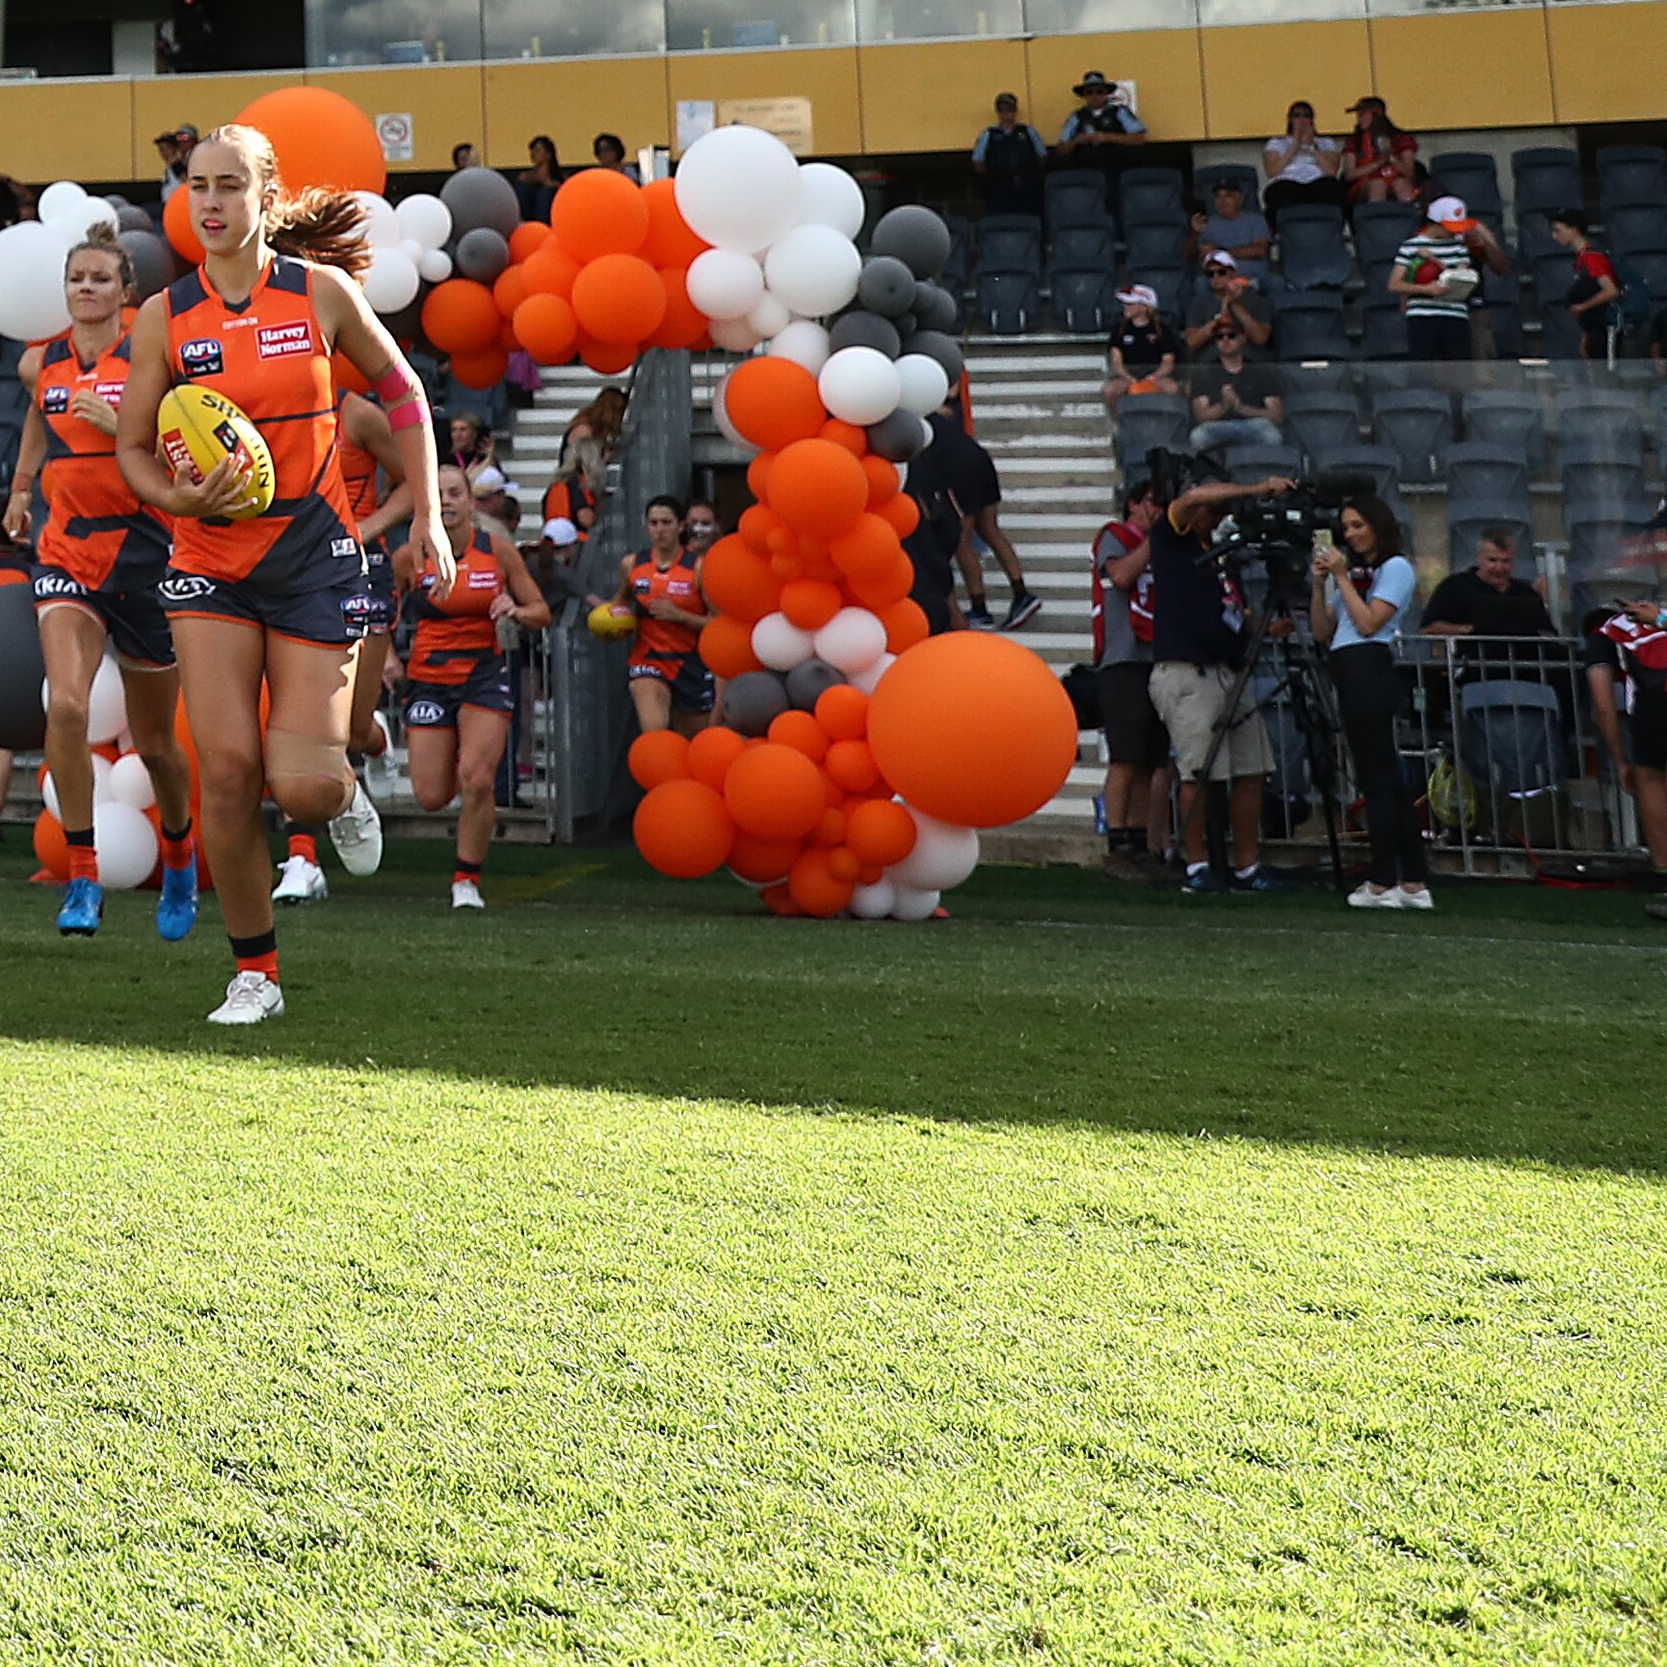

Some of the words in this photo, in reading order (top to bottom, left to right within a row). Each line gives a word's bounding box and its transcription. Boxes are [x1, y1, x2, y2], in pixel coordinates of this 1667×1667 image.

[260, 325, 306, 343] Harvey
[184, 342, 219, 358] AFL
[260, 339, 311, 356] Norman
